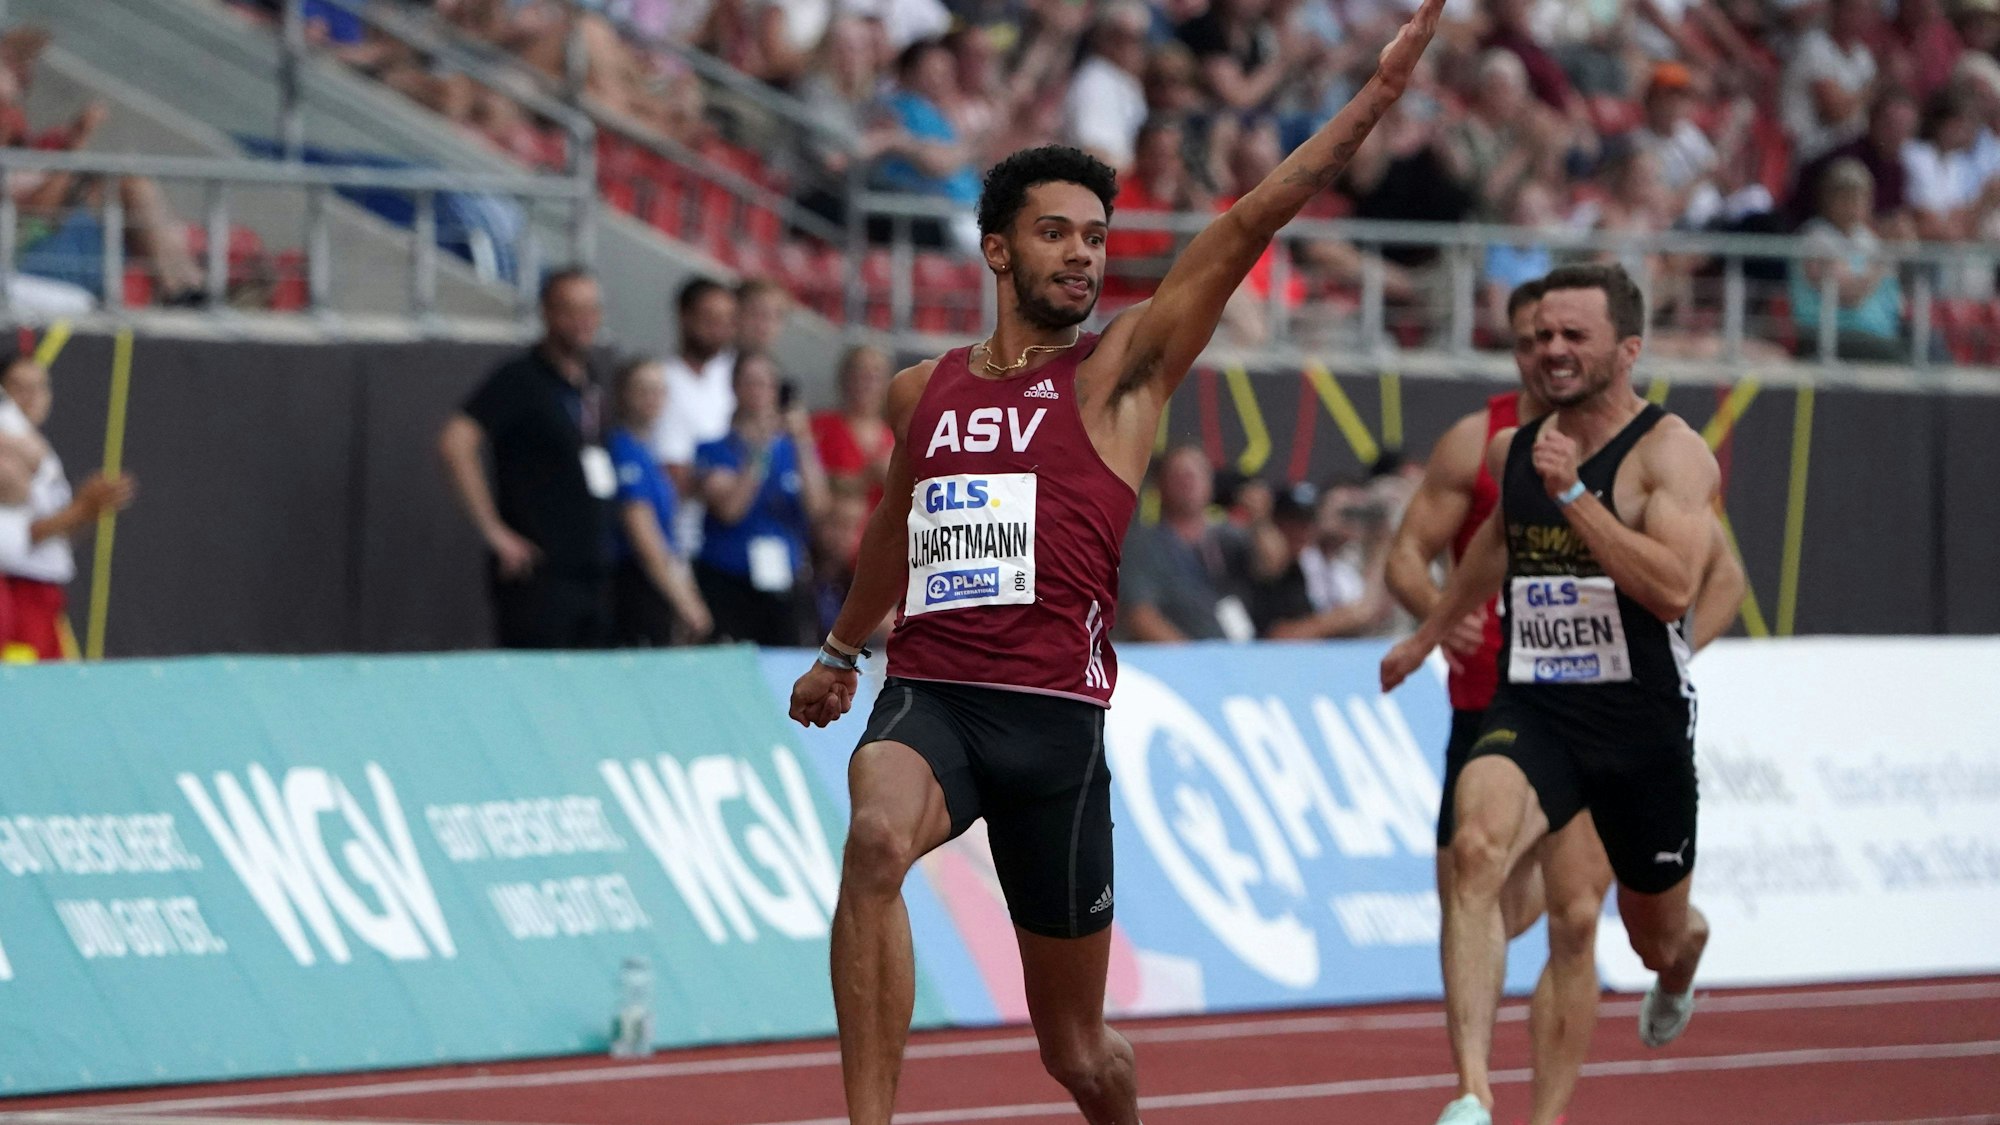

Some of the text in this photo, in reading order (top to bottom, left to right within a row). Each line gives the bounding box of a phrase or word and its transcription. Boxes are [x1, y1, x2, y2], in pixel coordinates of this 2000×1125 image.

[1024, 389, 1059, 400] adidas
[925, 407, 1047, 458] ASV
[911, 522, 1027, 569] J.HARTMANN
[952, 573, 996, 589] PLAN
[954, 588, 995, 596] INTERNATIONAL
[1014, 570, 1026, 591] 460
[1518, 612, 1614, 649] HÜGEN
[176, 761, 458, 966] WGV
[600, 745, 842, 945] WGV
